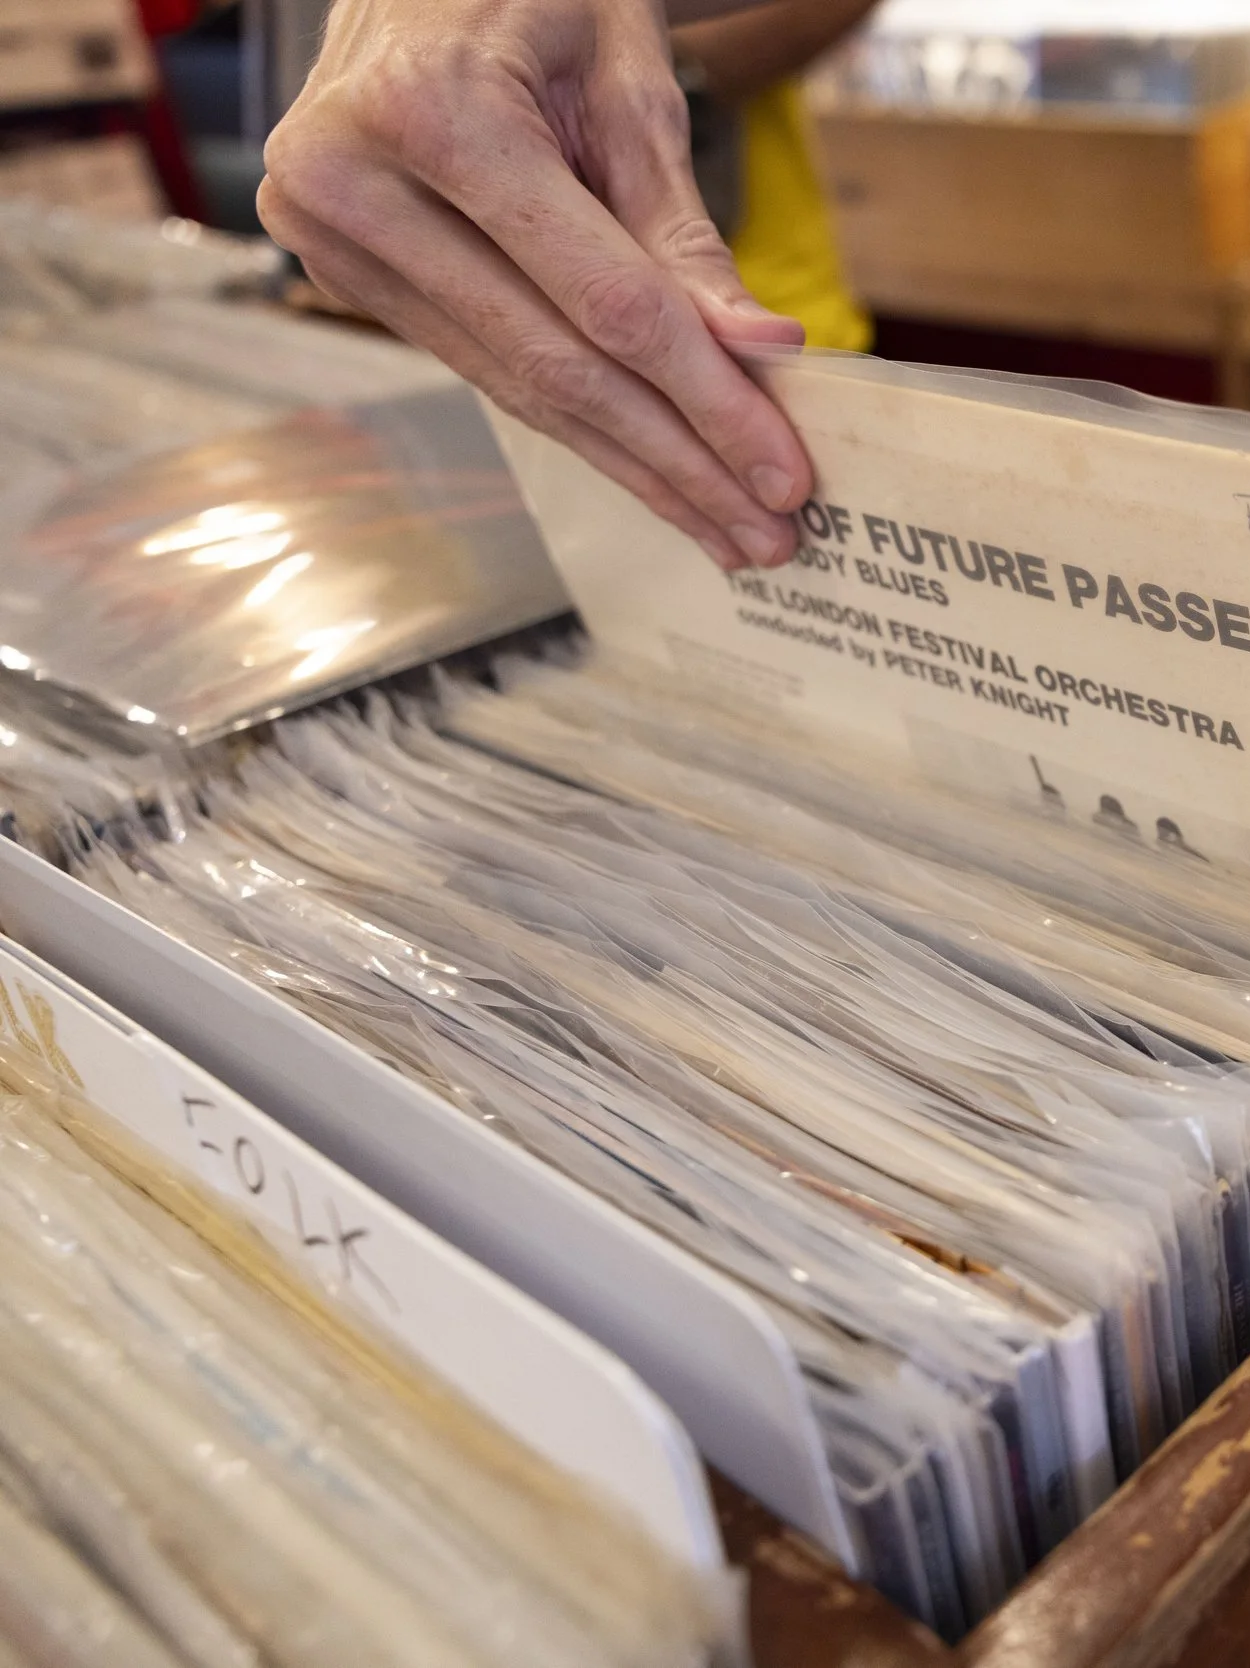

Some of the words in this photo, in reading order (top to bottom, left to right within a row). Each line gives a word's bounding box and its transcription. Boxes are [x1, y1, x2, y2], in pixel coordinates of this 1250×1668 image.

[796, 547, 846, 577] ODY
[854, 558, 950, 607] BLUES
[802, 500, 853, 545] OF
[862, 513, 1054, 602] FUTURE
[724, 569, 773, 603] THE
[775, 584, 883, 637] LONDON
[887, 618, 1027, 683] FESTIVAL
[1034, 664, 1245, 751] ORCHESTRA
[736, 607, 845, 653] conducted
[848, 638, 877, 668] by
[882, 649, 964, 693] PETER
[971, 675, 1070, 727] KNIGHT
[182, 1092, 402, 1312] FOLK
